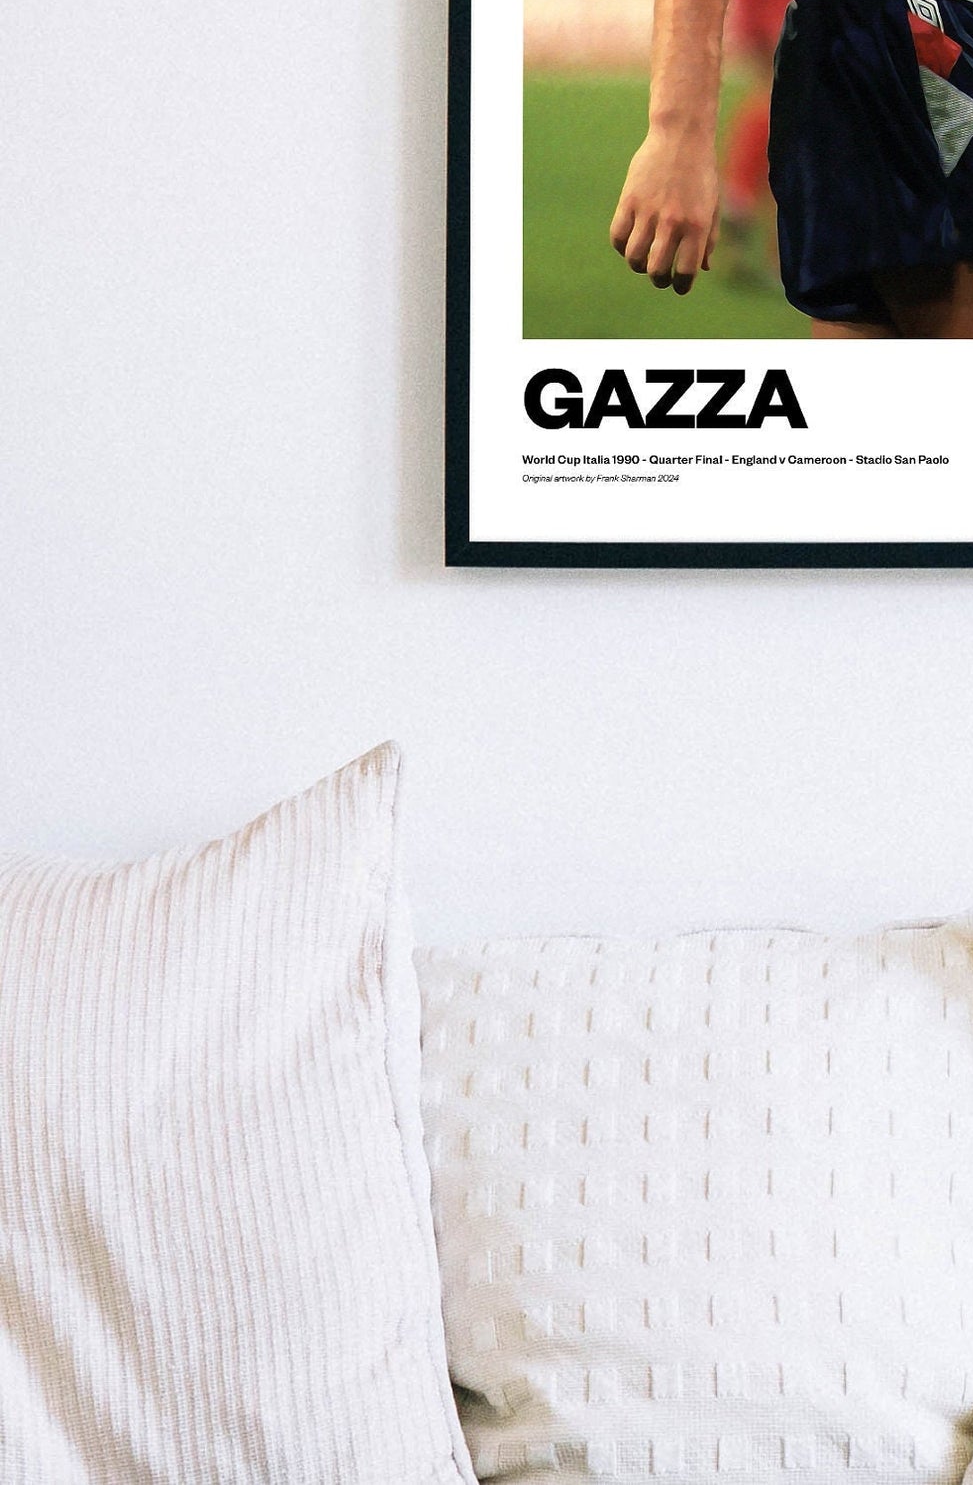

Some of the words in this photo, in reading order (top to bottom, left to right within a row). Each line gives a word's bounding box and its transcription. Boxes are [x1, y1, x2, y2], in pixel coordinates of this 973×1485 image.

[524, 368, 808, 429] GAZZA
[522, 455, 555, 464] World
[558, 455, 581, 466] Cup
[583, 455, 610, 464] Italia
[612, 455, 640, 464] 1990
[649, 455, 693, 464] Quarter
[696, 455, 722, 464] Final
[732, 455, 777, 466] England
[788, 455, 846, 464] Cameroon
[856, 455, 892, 464] Stadio
[894, 455, 916, 464] San
[919, 455, 949, 464] Paolo
[522, 475, 553, 483] Original
[585, 475, 596, 483] by
